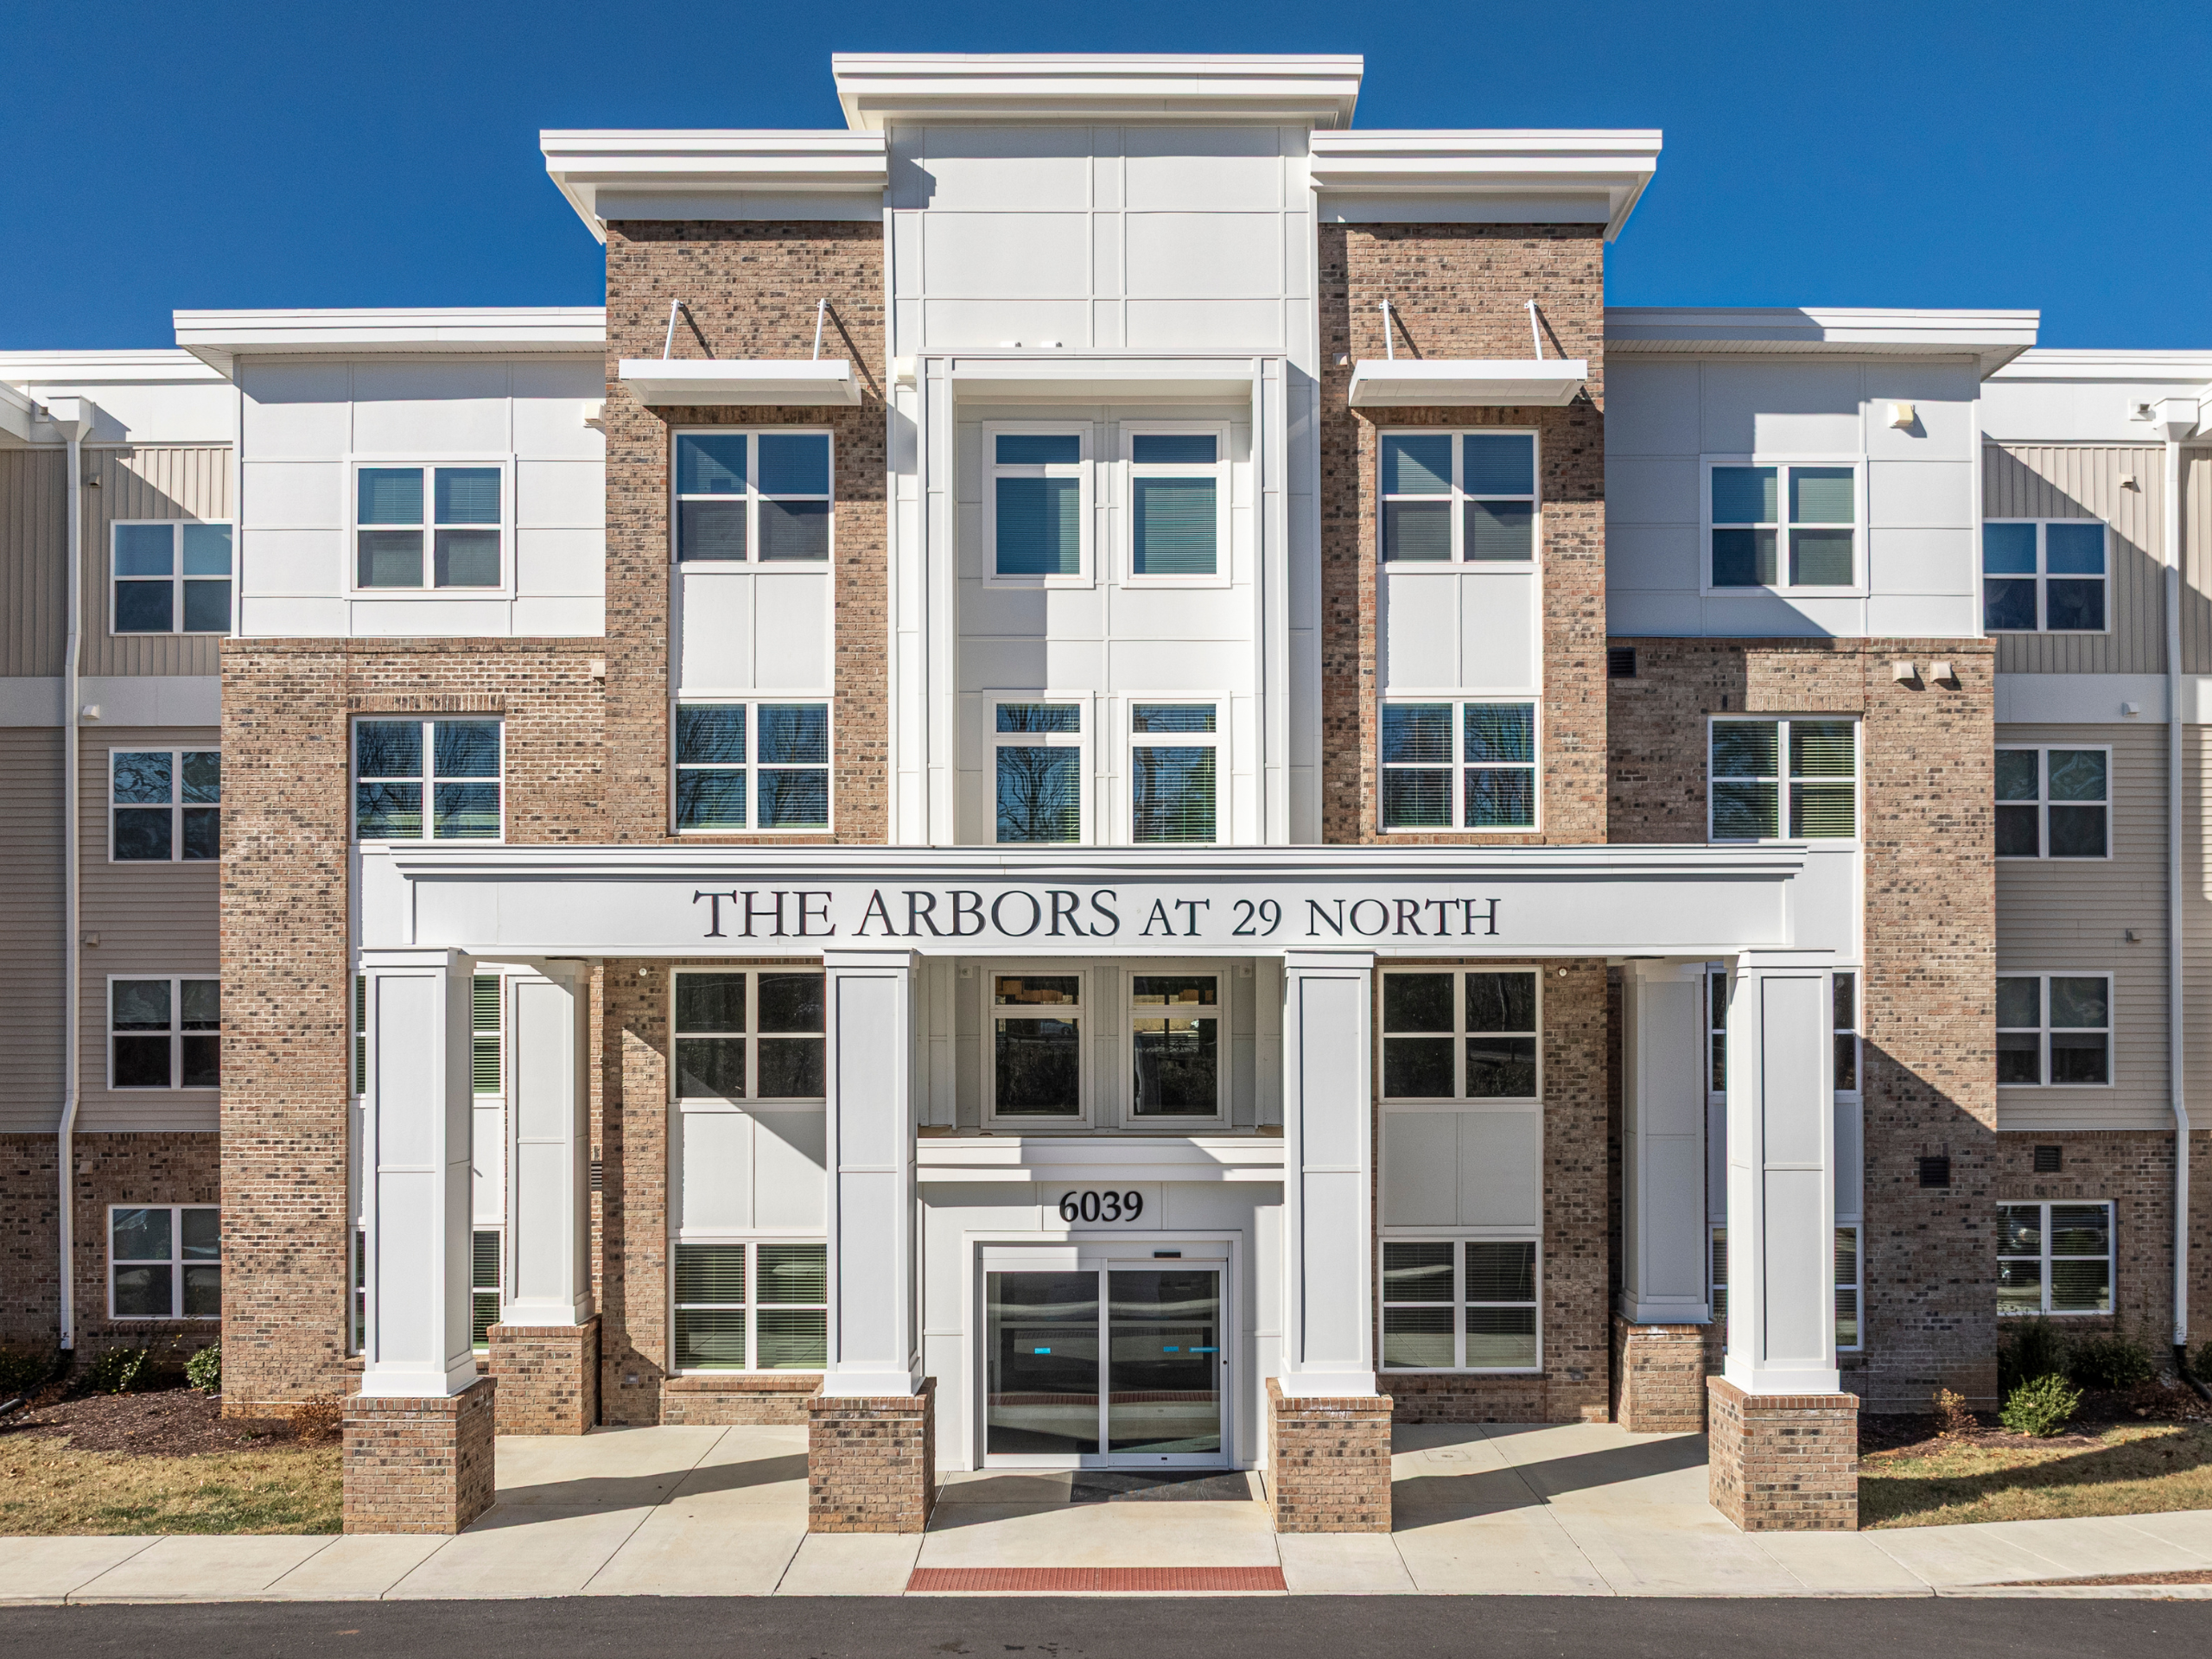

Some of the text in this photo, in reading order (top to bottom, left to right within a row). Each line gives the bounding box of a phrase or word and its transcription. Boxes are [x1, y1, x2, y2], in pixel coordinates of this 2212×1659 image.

[692, 889, 1502, 938] THE ARBORS AT 29 NORTH
[1058, 1190, 1144, 1223] 6039
